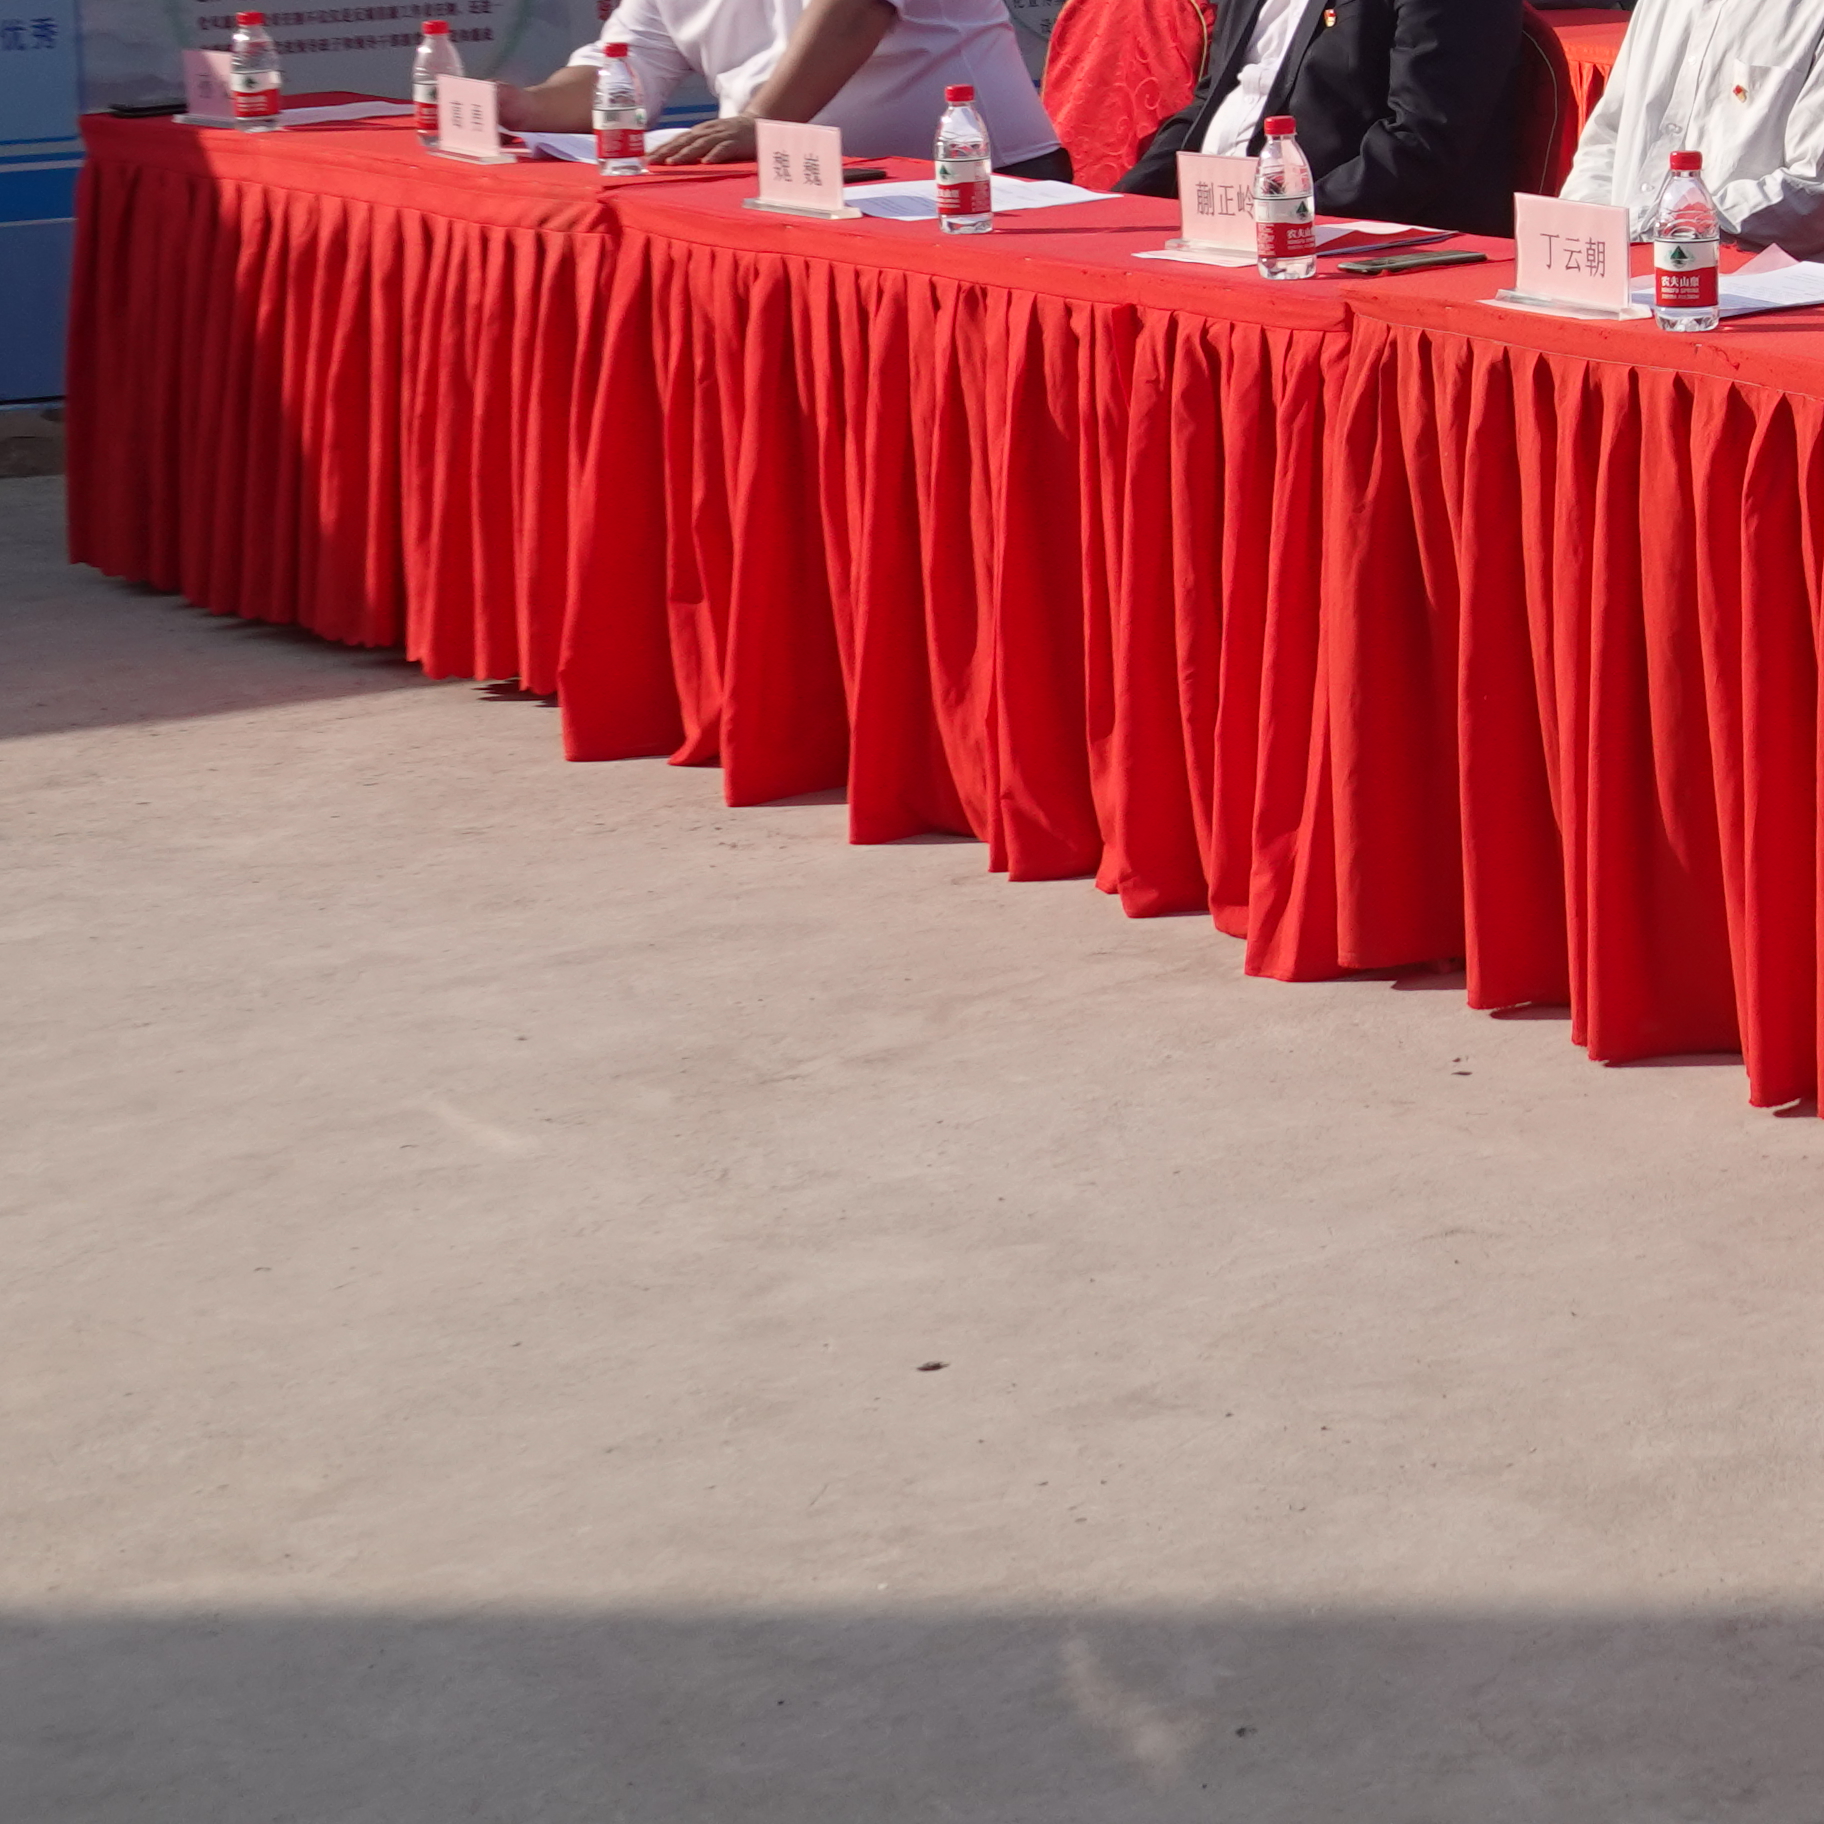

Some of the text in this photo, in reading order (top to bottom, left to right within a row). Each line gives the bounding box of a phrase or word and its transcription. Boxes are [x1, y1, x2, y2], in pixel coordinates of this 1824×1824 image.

[1540, 233, 1606, 278] 丁云朝
[1661, 276, 1699, 287] 农夫山泉
